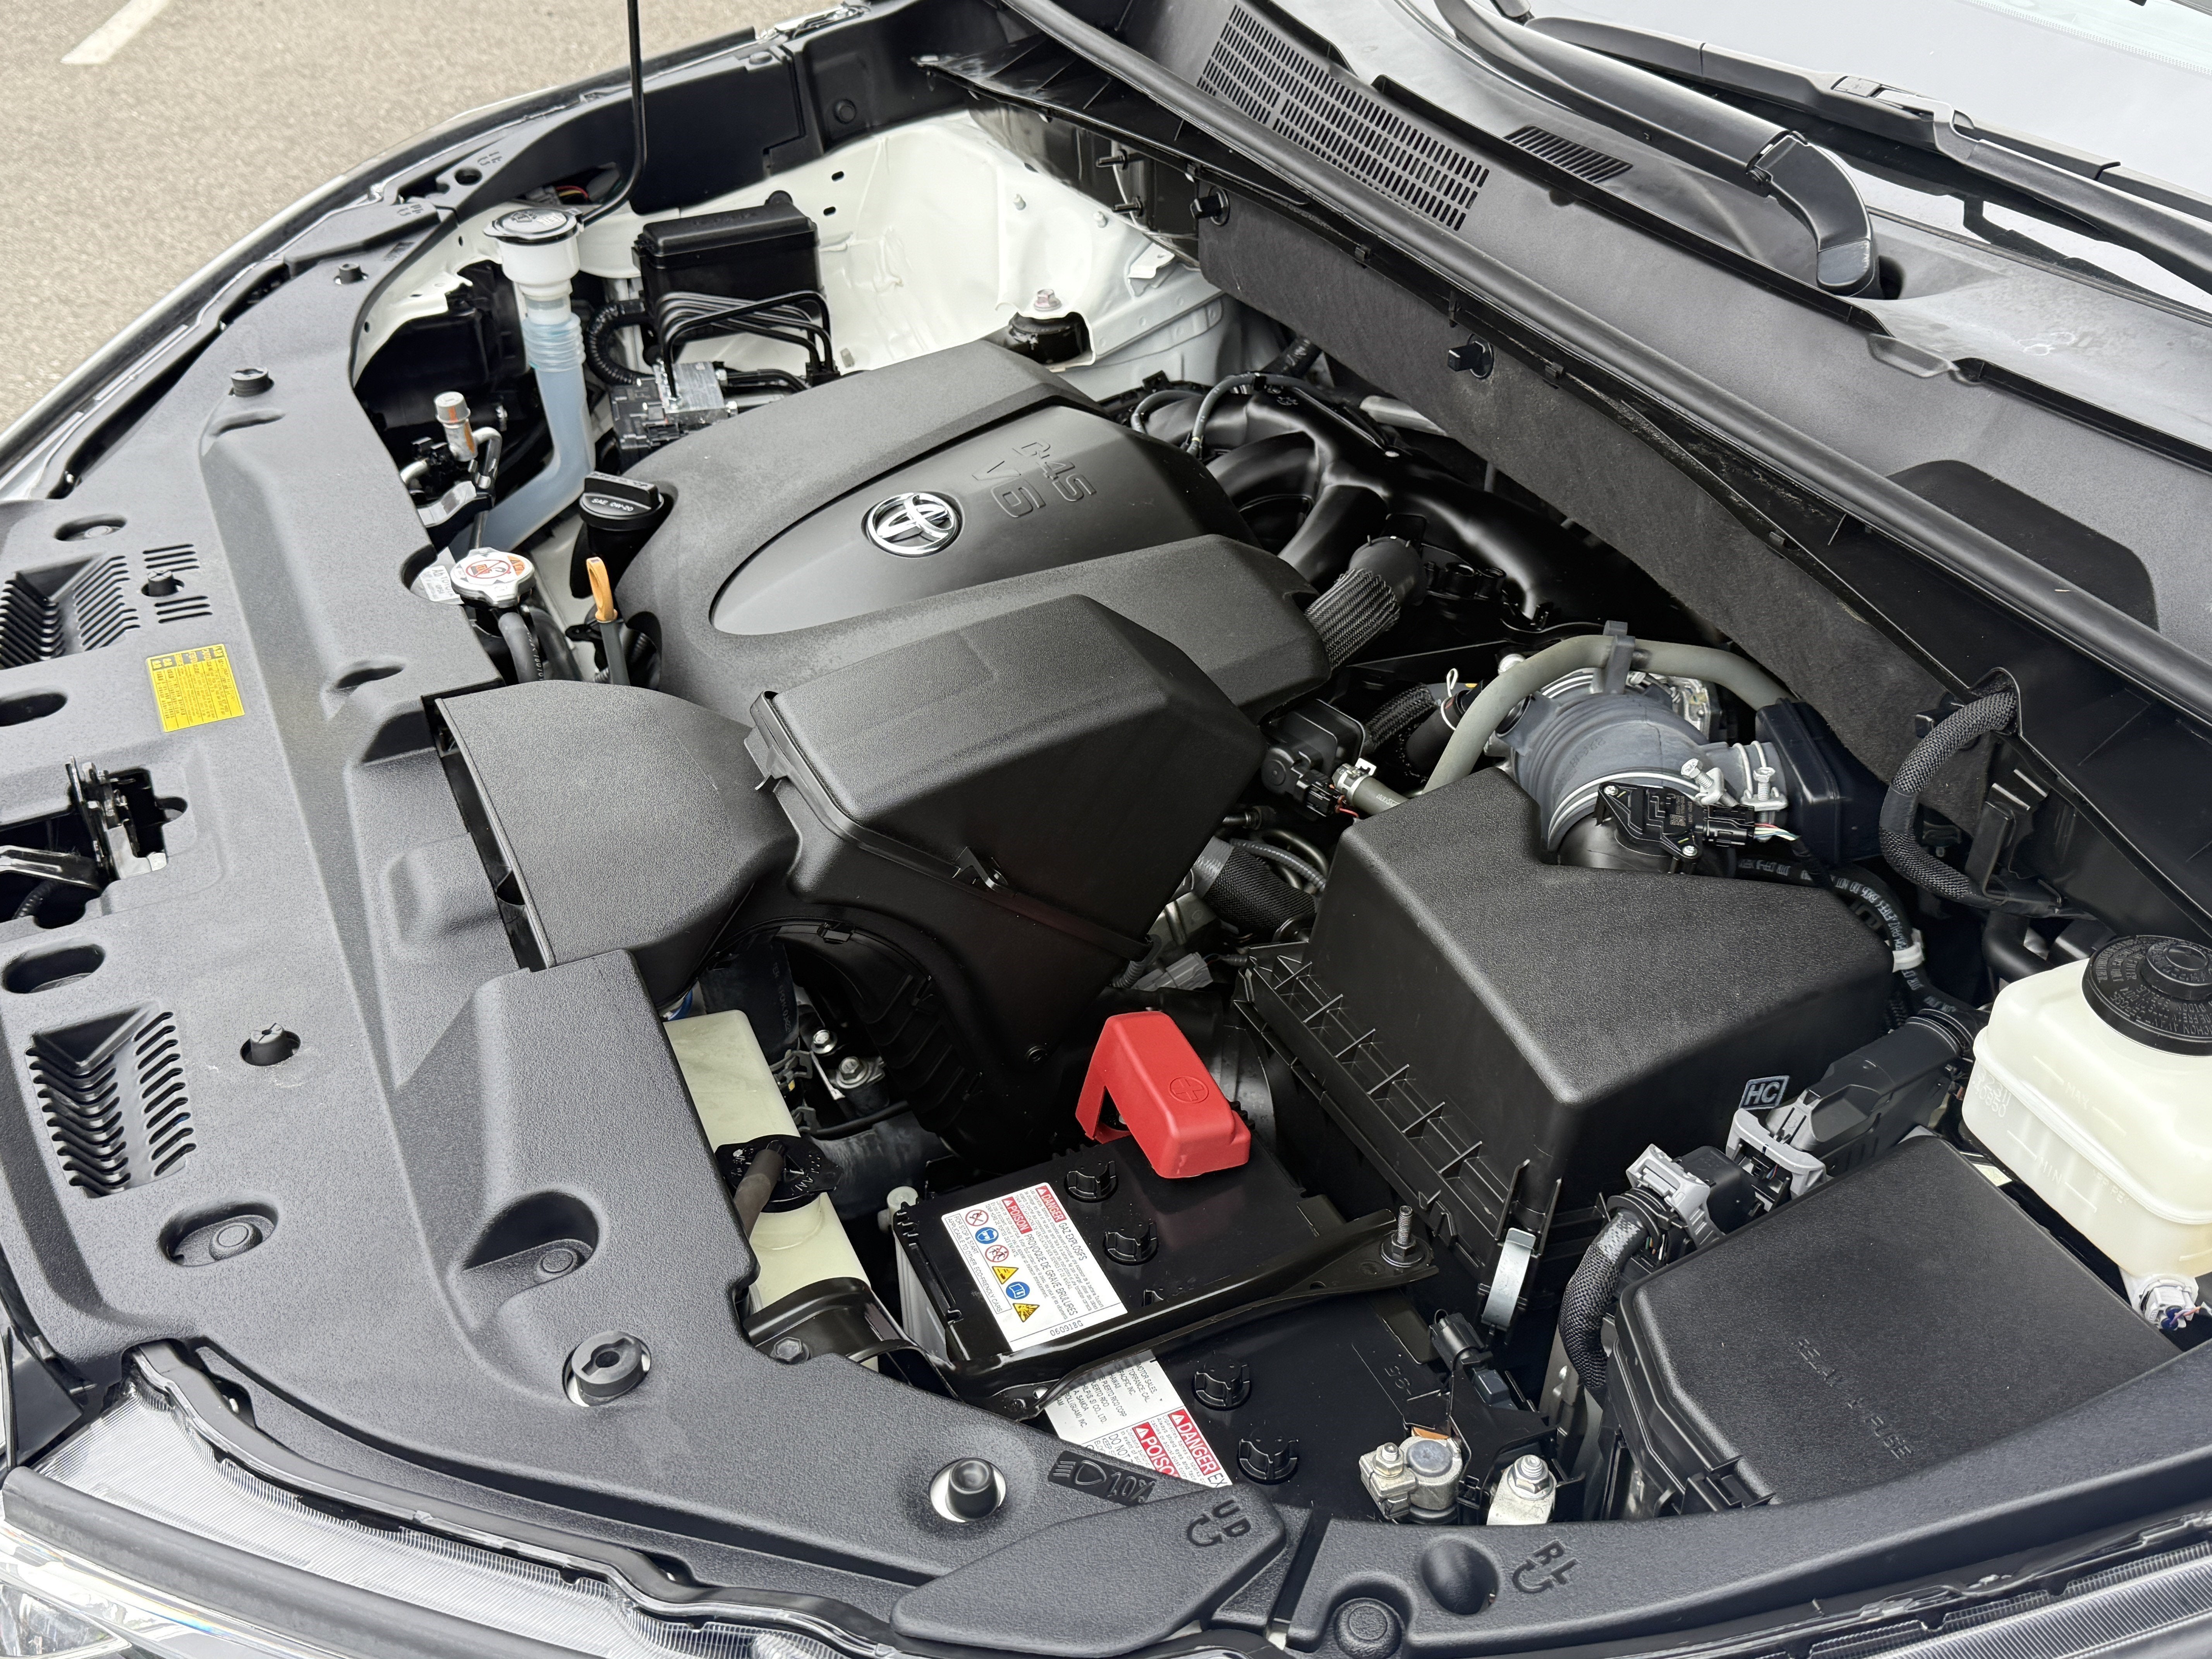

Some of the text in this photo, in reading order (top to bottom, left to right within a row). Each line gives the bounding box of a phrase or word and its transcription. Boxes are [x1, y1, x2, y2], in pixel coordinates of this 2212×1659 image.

[591, 496, 634, 512] SAE 0W-20
[972, 460, 1046, 518] V6
[1745, 1082, 1779, 1105] HC
[954, 1215, 963, 1225] FOR
[959, 1225, 969, 1237] STOP
[967, 1240, 979, 1254] START
[1041, 1194, 1088, 1261] DANGER GAZ EXPLOSIFS
[947, 1217, 965, 1243] APPLICABLE
[965, 1250, 977, 1266] OTHER
[974, 1266, 995, 1299] ECO-FRIENDLY
[991, 1298, 1003, 1312] CARS
[1007, 1205, 1079, 1316] POISON PROVOQUE DE GRAVE BRULURES
[1049, 1320, 1084, 1337] 060918G
[1075, 1395, 1090, 1411] SAMOA
[1099, 1396, 1110, 1407] RICO
[1101, 1380, 1115, 1396] PUERTO
[1109, 1396, 1121, 1406] RICO
[1108, 1433, 1123, 1445] DO
[1114, 1444, 1130, 1460] NOT
[1139, 1435, 1178, 1481] POISO
[1175, 1422, 1219, 1474] DANGER
[1211, 1498, 1252, 1537] UD
[1532, 1539, 1580, 1586] RL
